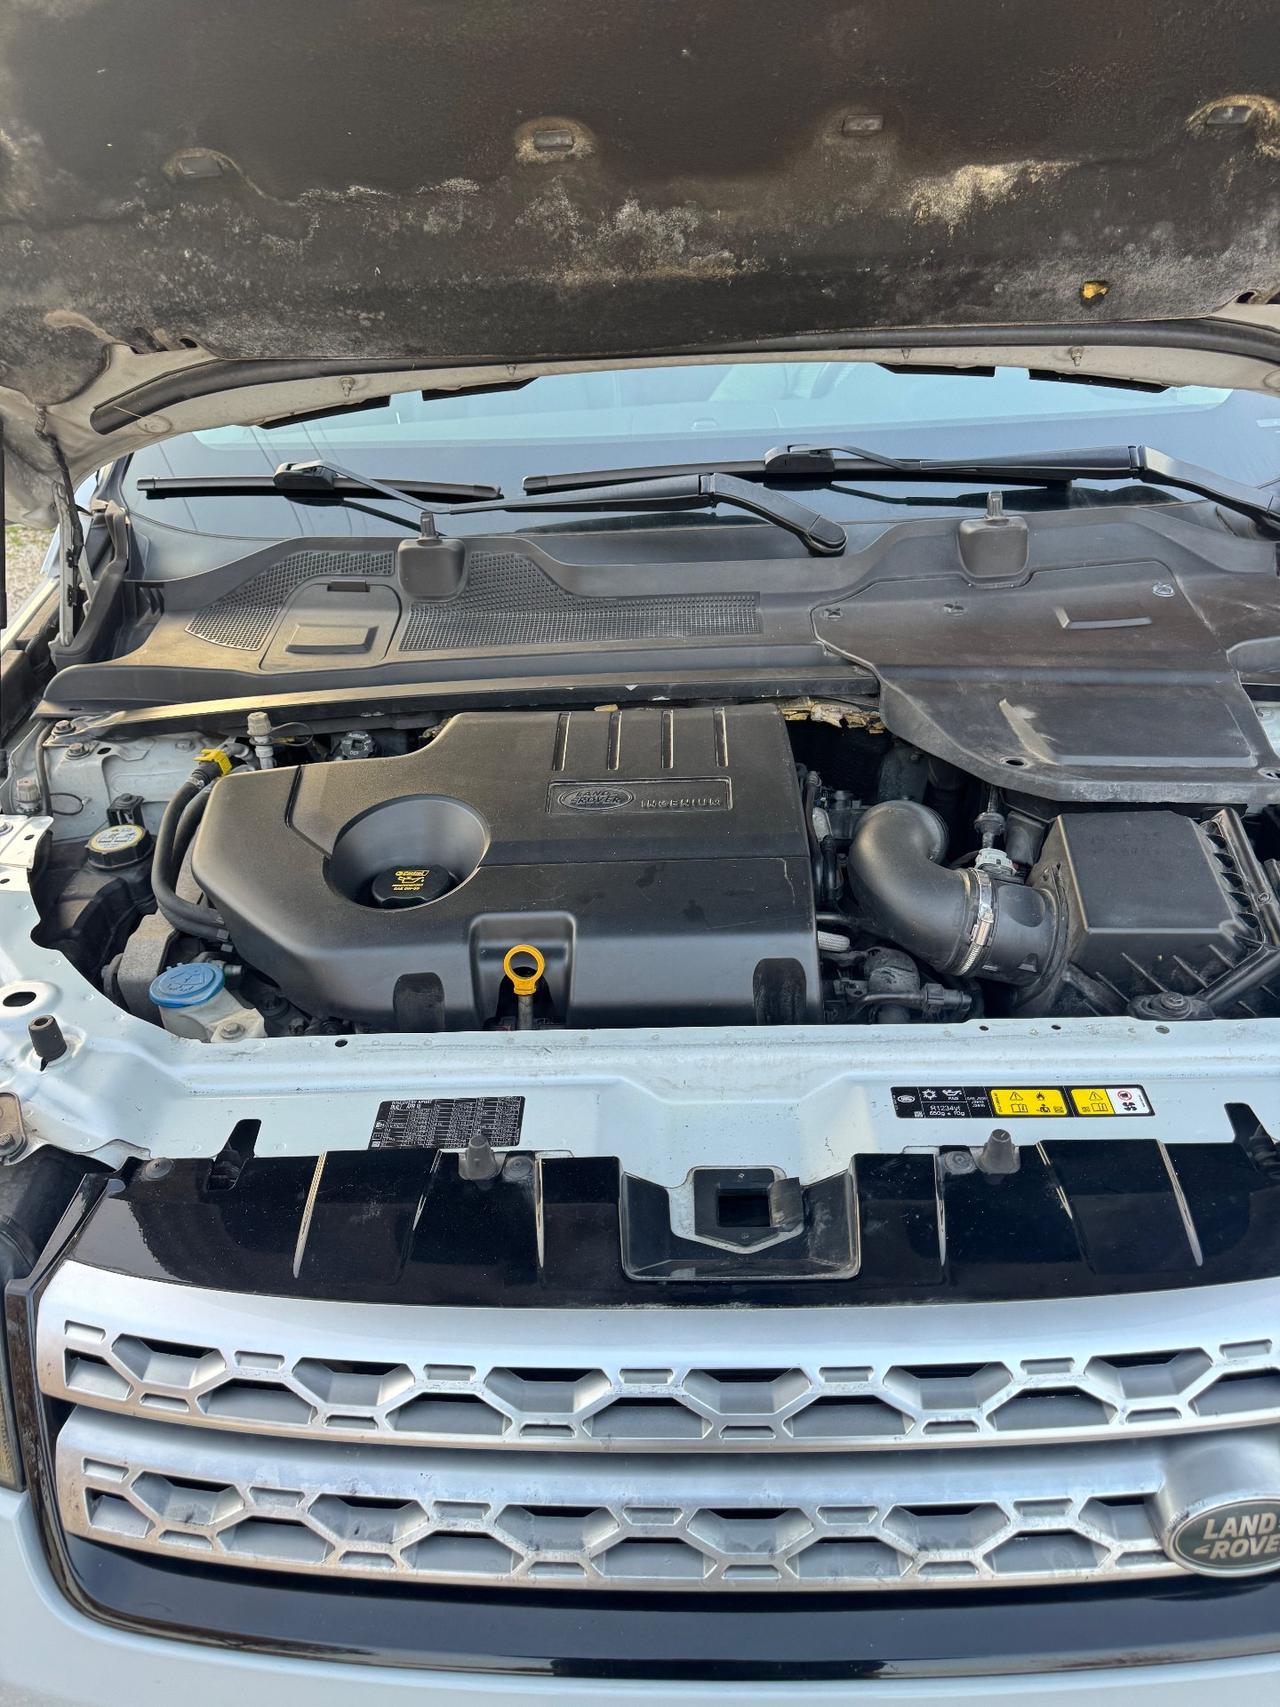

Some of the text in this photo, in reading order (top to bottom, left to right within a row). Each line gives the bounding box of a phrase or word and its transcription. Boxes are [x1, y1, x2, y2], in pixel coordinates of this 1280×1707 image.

[640, 799, 721, 808] INGENIUM
[1203, 1512, 1277, 1540] LAND
[1209, 1533, 1280, 1560] ROVE
